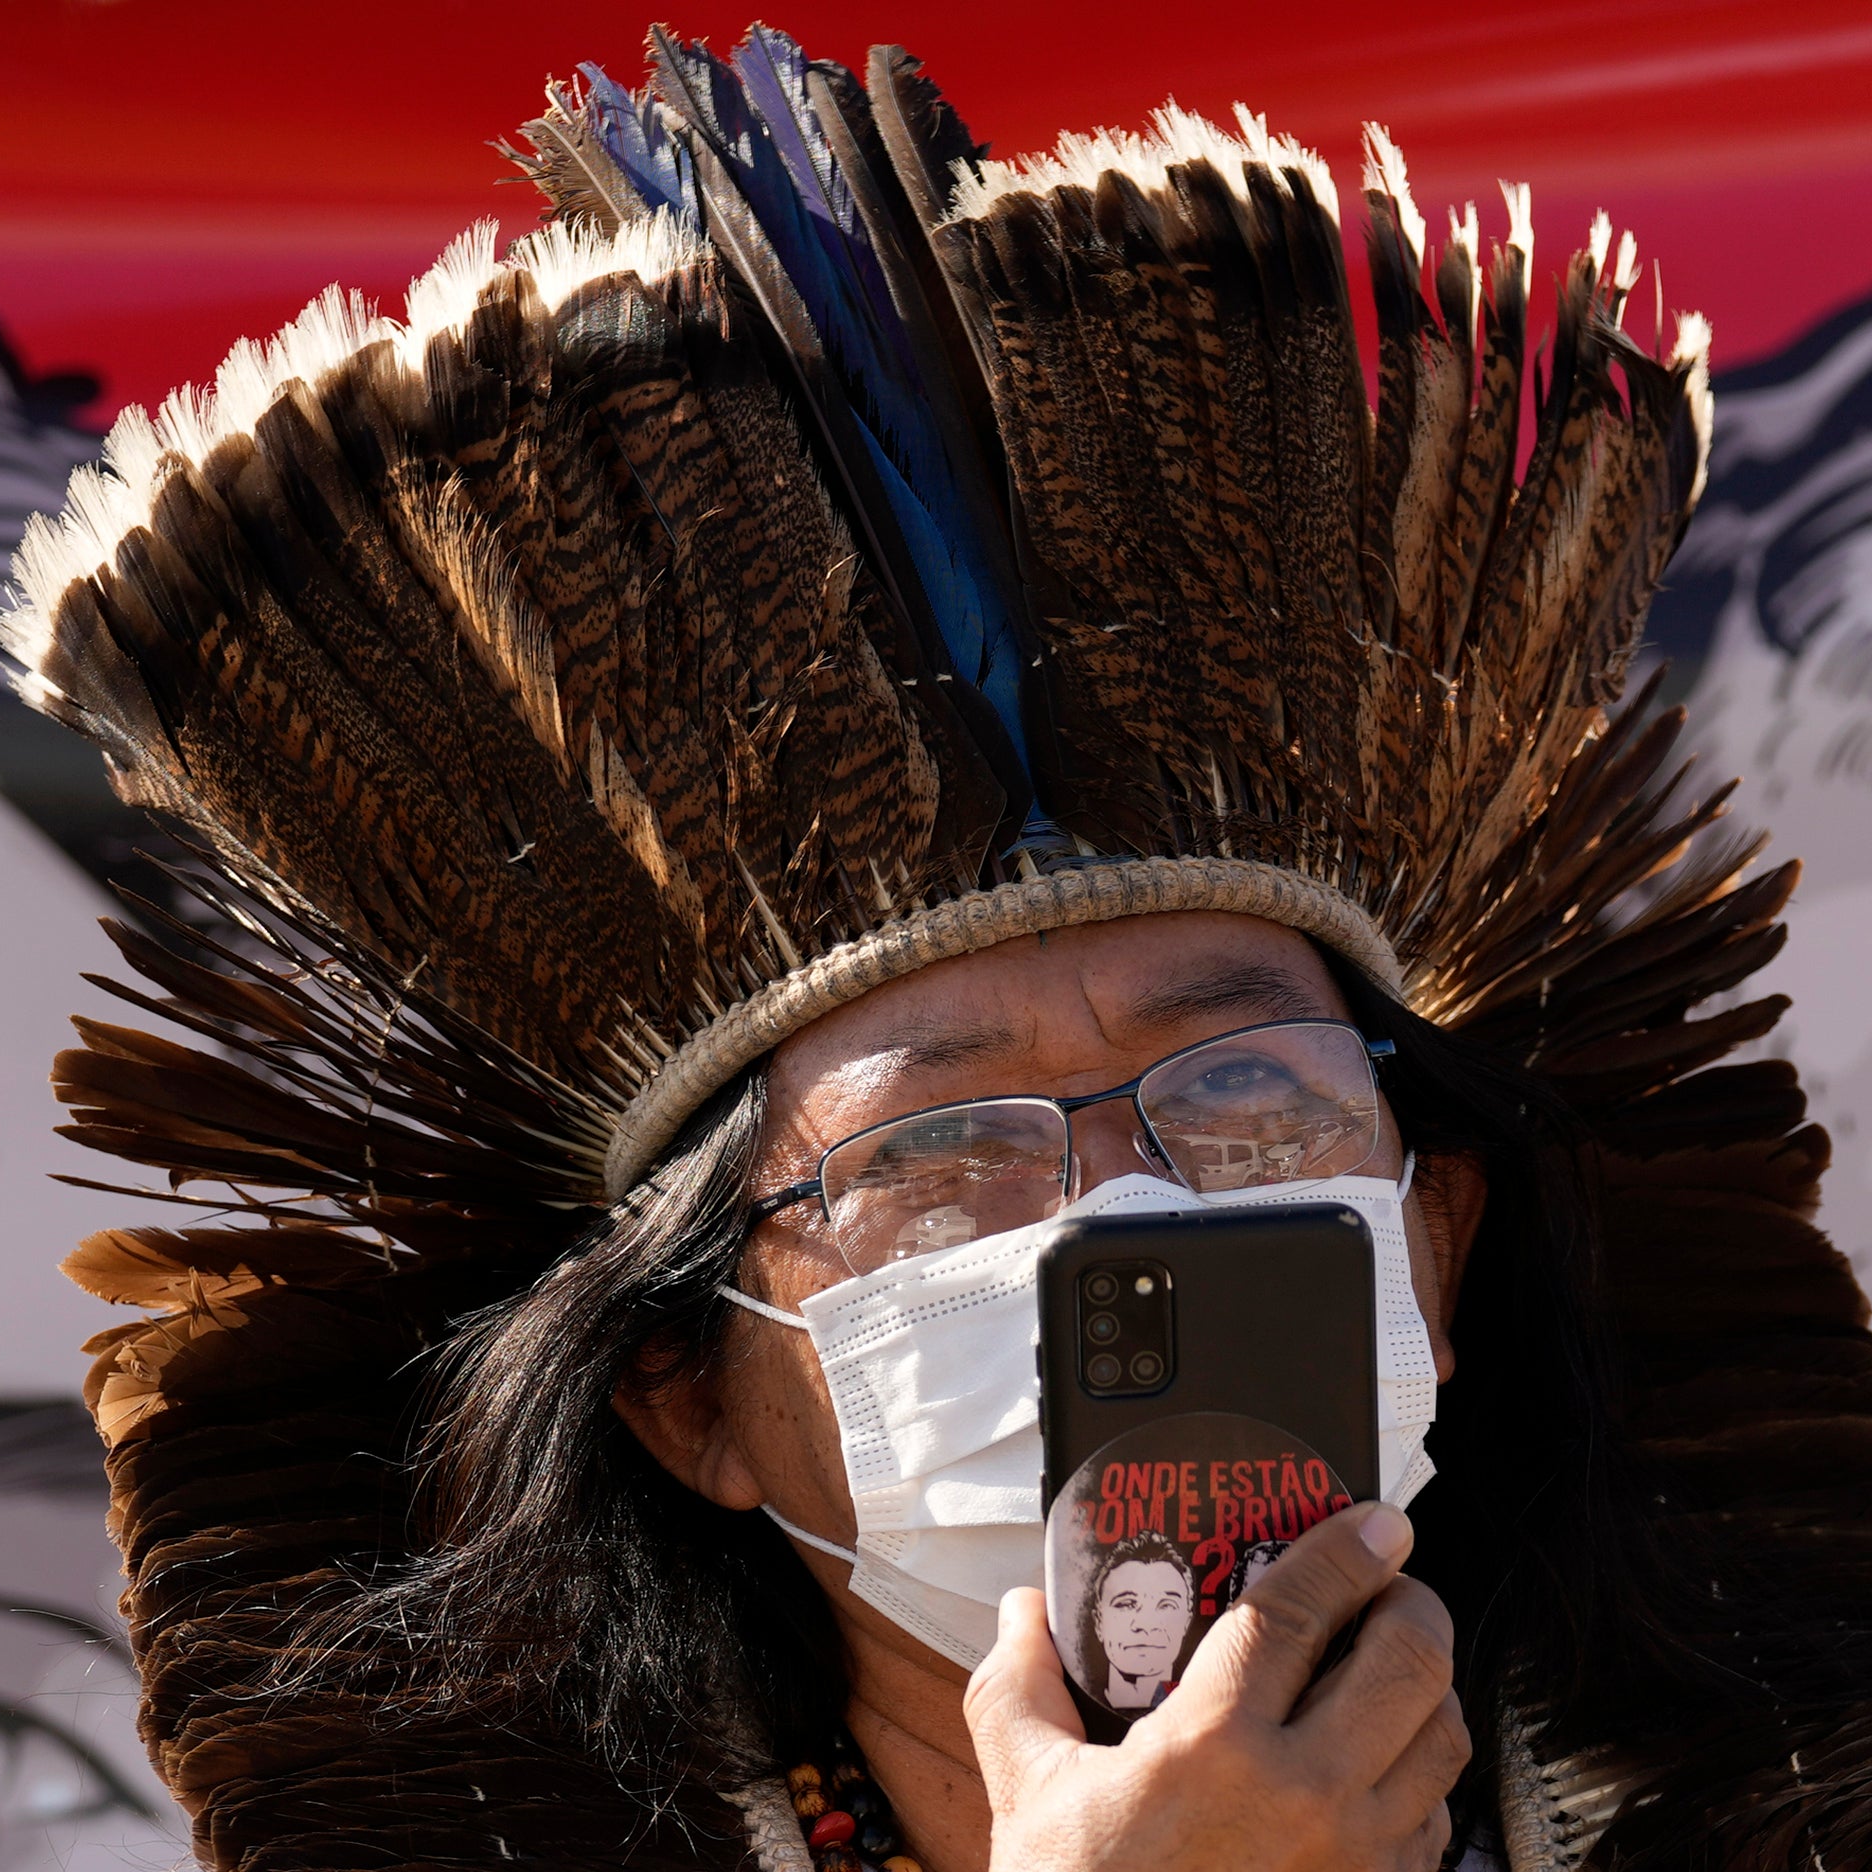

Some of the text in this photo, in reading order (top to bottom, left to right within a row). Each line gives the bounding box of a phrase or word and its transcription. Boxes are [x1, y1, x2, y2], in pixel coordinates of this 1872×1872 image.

[1100, 1452, 1331, 1499] ONDE ESTÃO
[1177, 1498, 1201, 1543] E
[1191, 1536, 1236, 1616] ?
